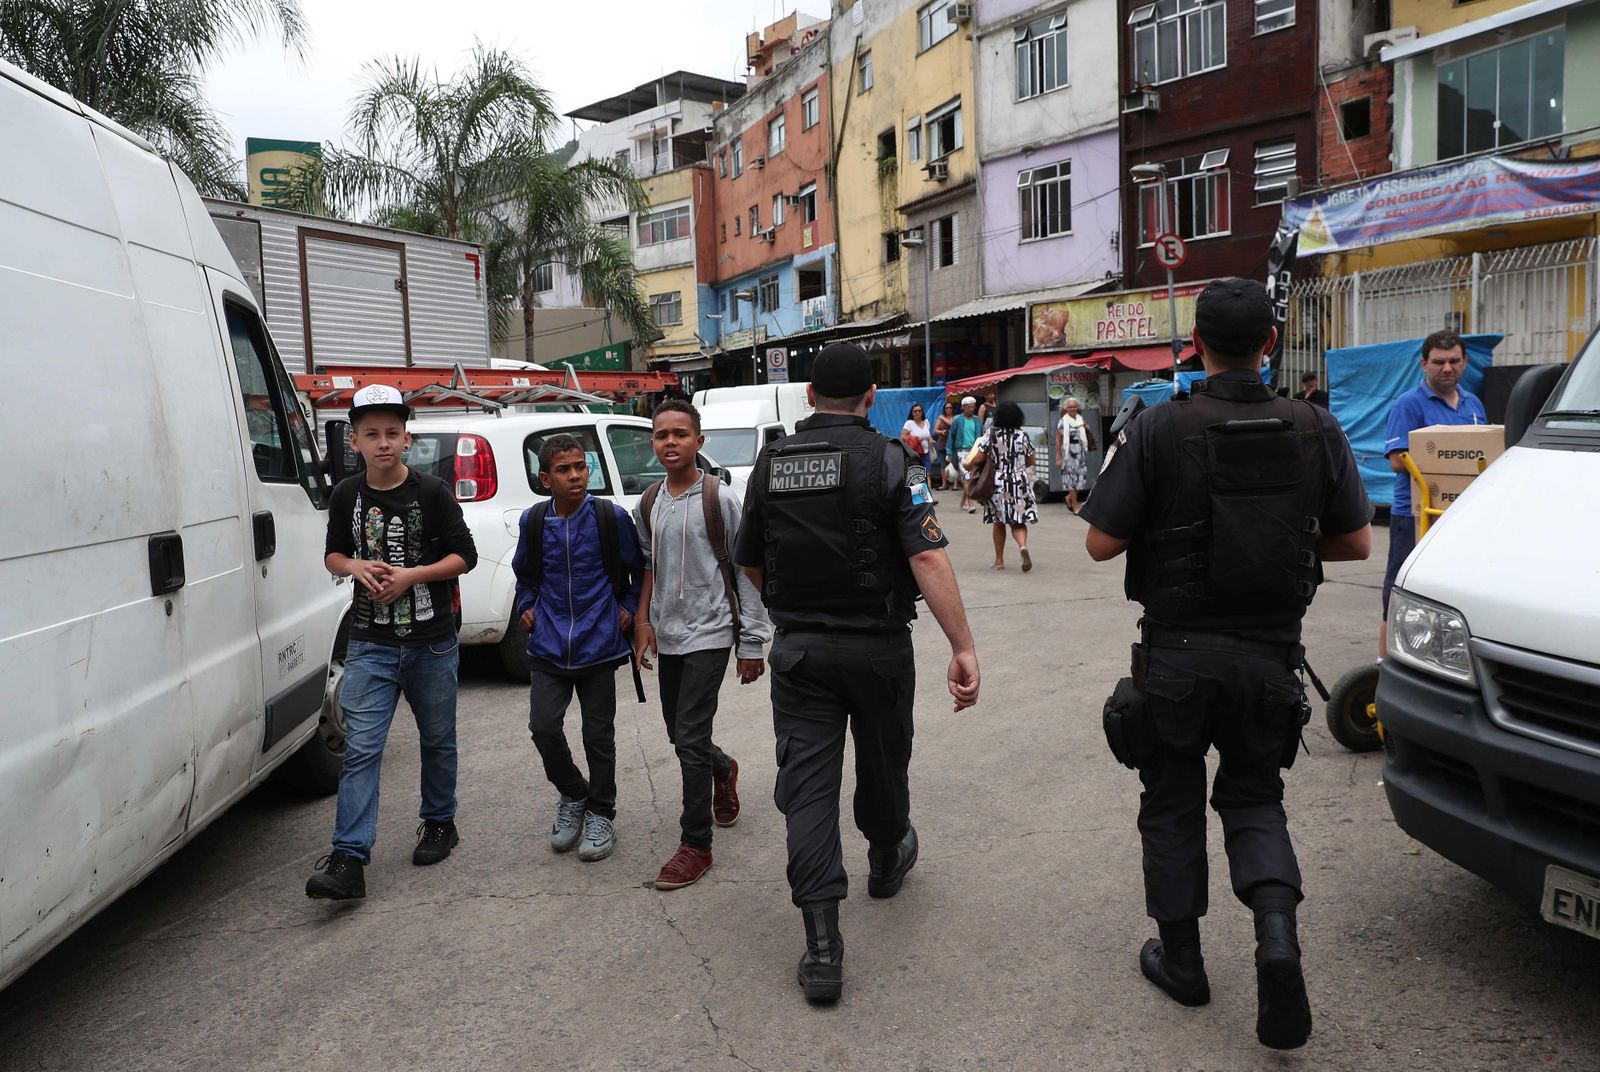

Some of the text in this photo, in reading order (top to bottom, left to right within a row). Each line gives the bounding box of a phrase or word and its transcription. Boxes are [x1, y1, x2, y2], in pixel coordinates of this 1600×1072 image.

[1327, 187, 1370, 208] IGREJA
[1107, 302, 1144, 319] REI DO
[1096, 316, 1157, 341] PASTEL
[774, 353, 780, 364] E
[772, 457, 837, 476] POLÍCIA
[771, 473, 837, 490] MILITAR
[278, 642, 297, 665] RNTRC
